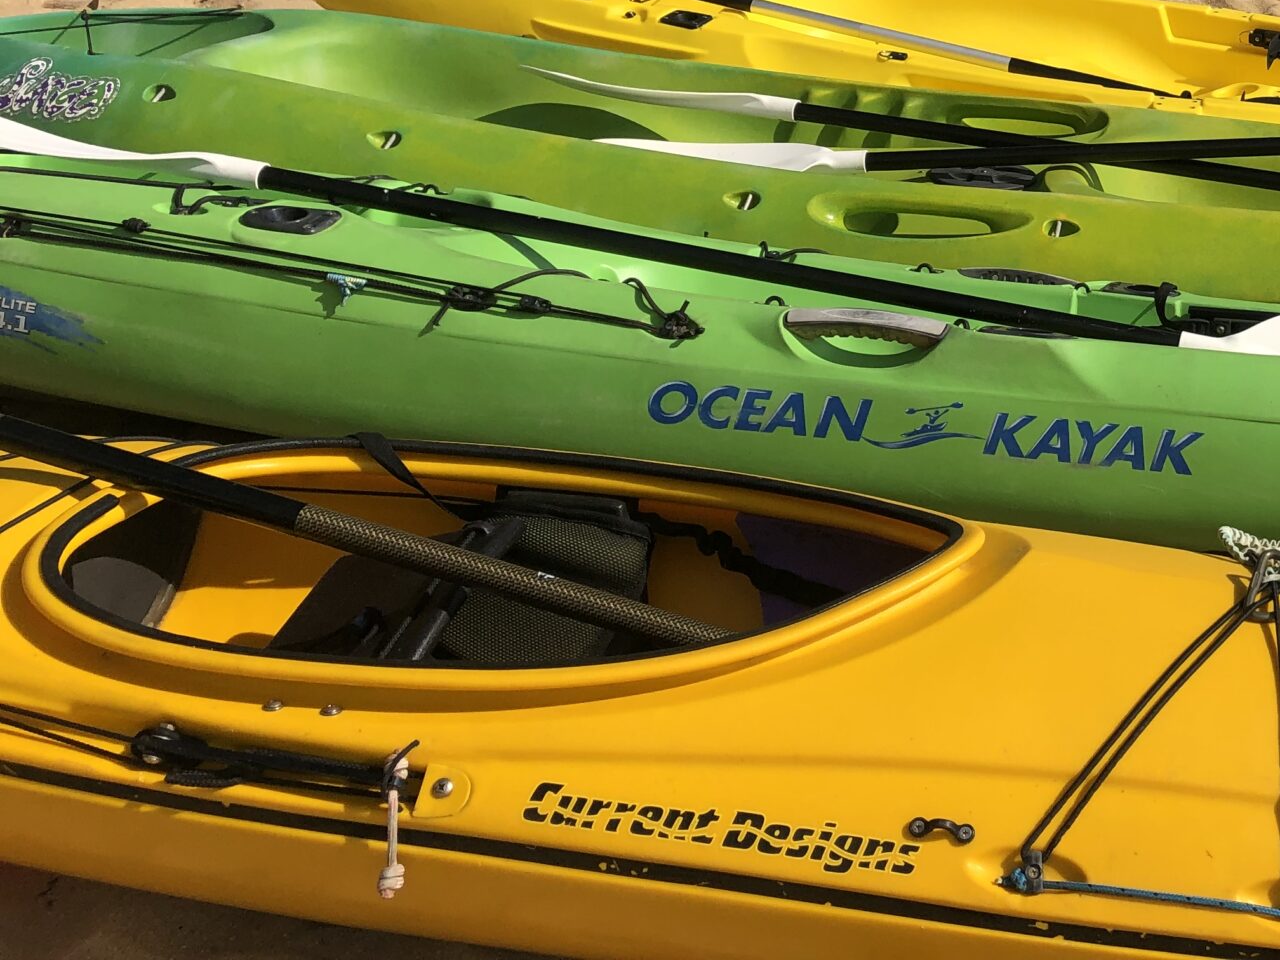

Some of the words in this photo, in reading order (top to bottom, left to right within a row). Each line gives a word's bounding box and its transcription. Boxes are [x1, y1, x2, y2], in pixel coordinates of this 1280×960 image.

[0, 296, 37, 314] LITE
[648, 380, 873, 441] OCEAN
[982, 411, 1205, 476] KAYAK
[522, 782, 720, 845] Current
[721, 810, 921, 874] Designs
